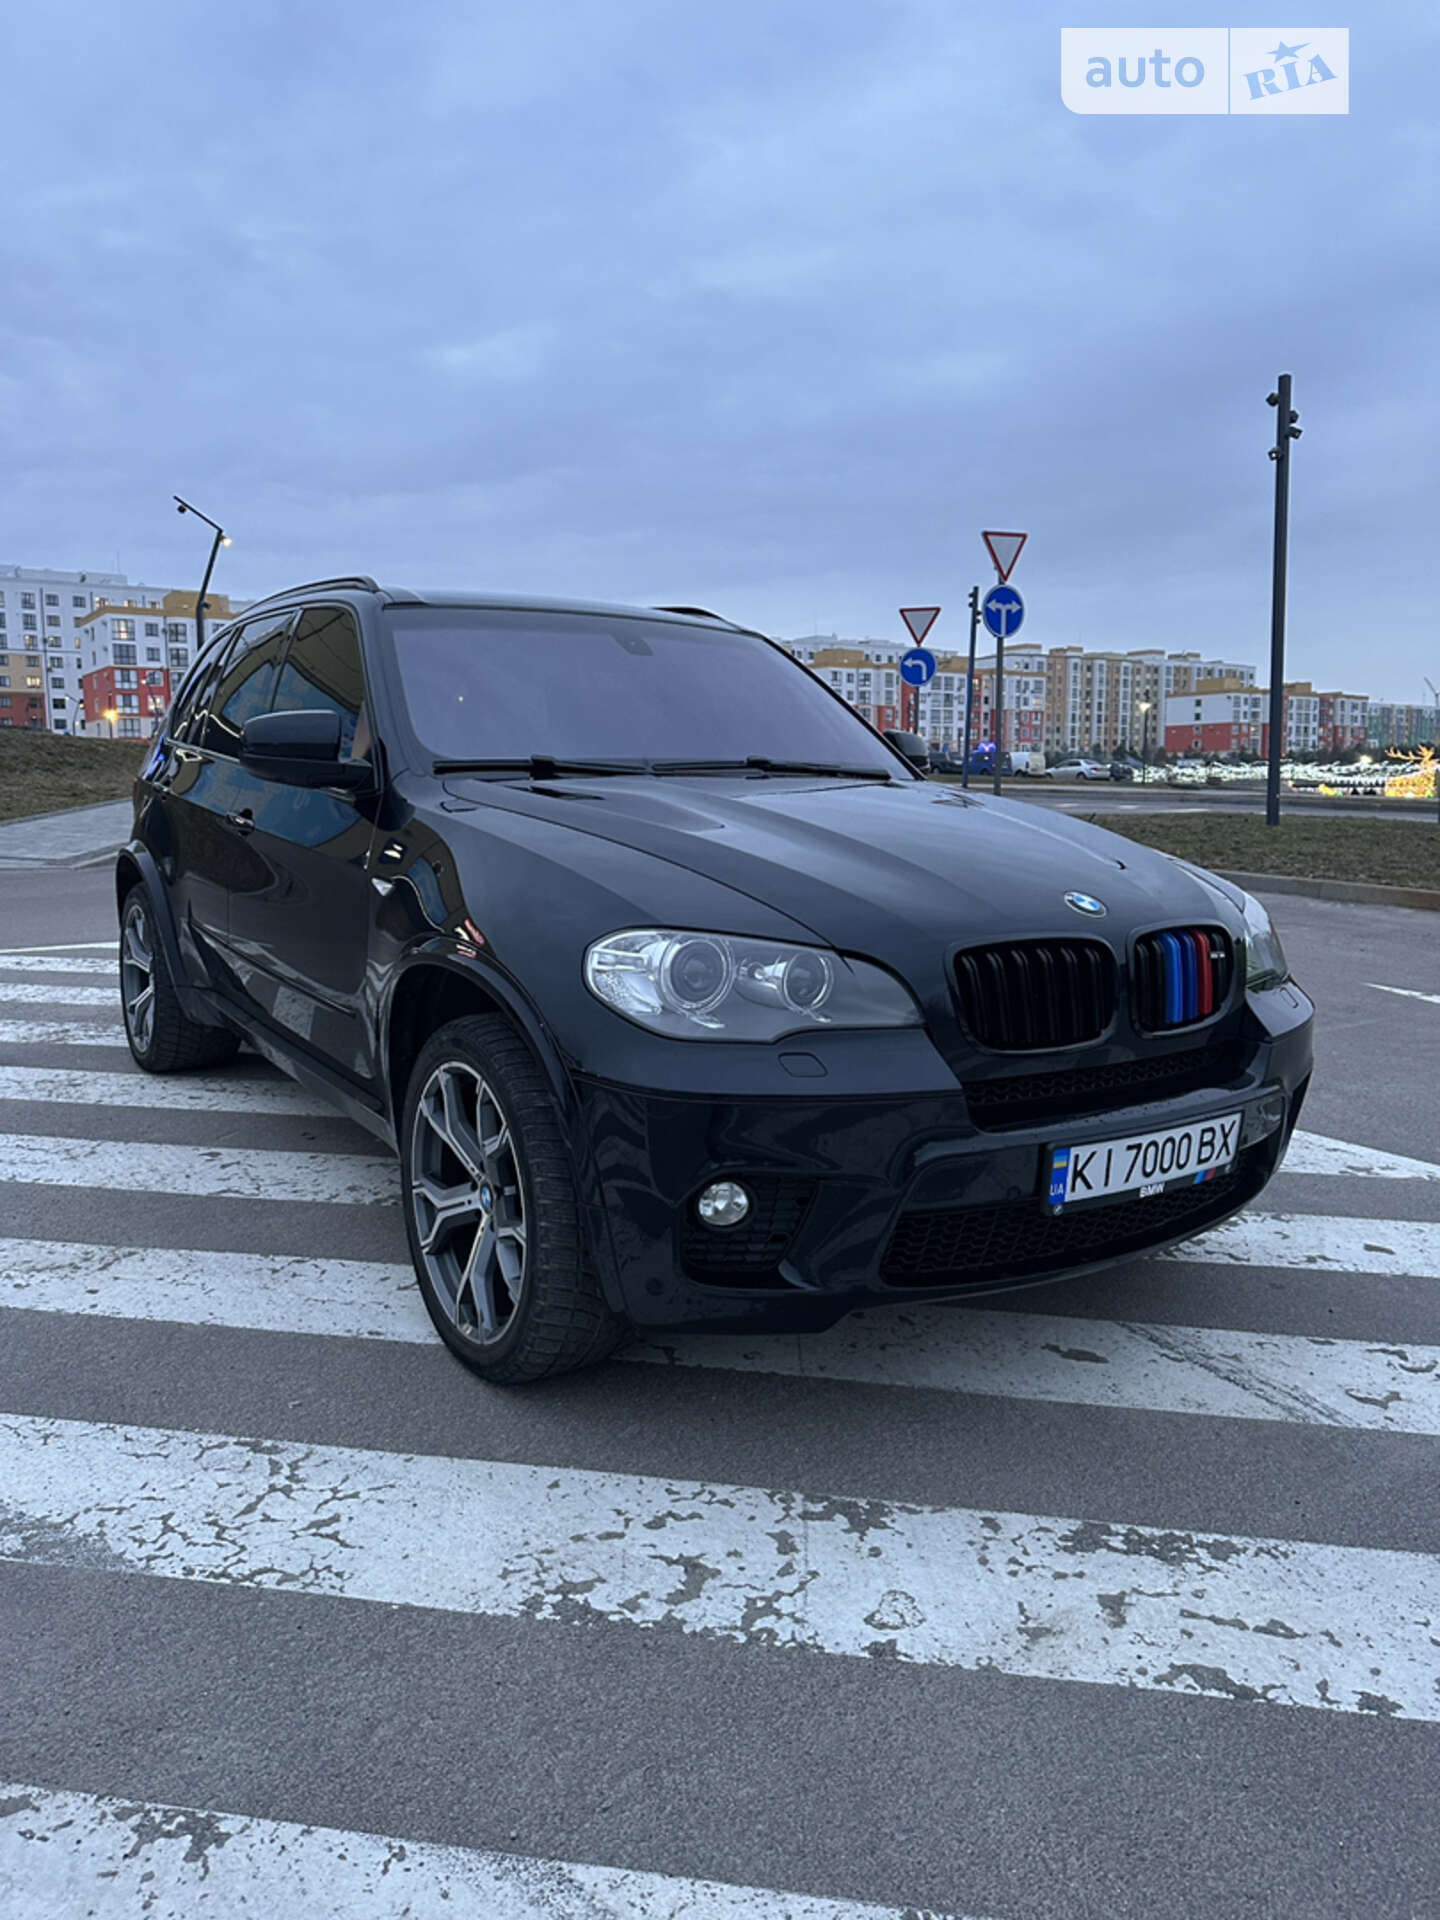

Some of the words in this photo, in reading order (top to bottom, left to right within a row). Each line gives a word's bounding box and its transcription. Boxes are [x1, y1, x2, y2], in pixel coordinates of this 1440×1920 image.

[1070, 1148, 1113, 1193] KI
[1124, 1132, 1192, 1184] 7000
[1196, 1119, 1237, 1166] BX
[1050, 1183, 1065, 1197] UA
[1139, 1182, 1165, 1198] BMW
